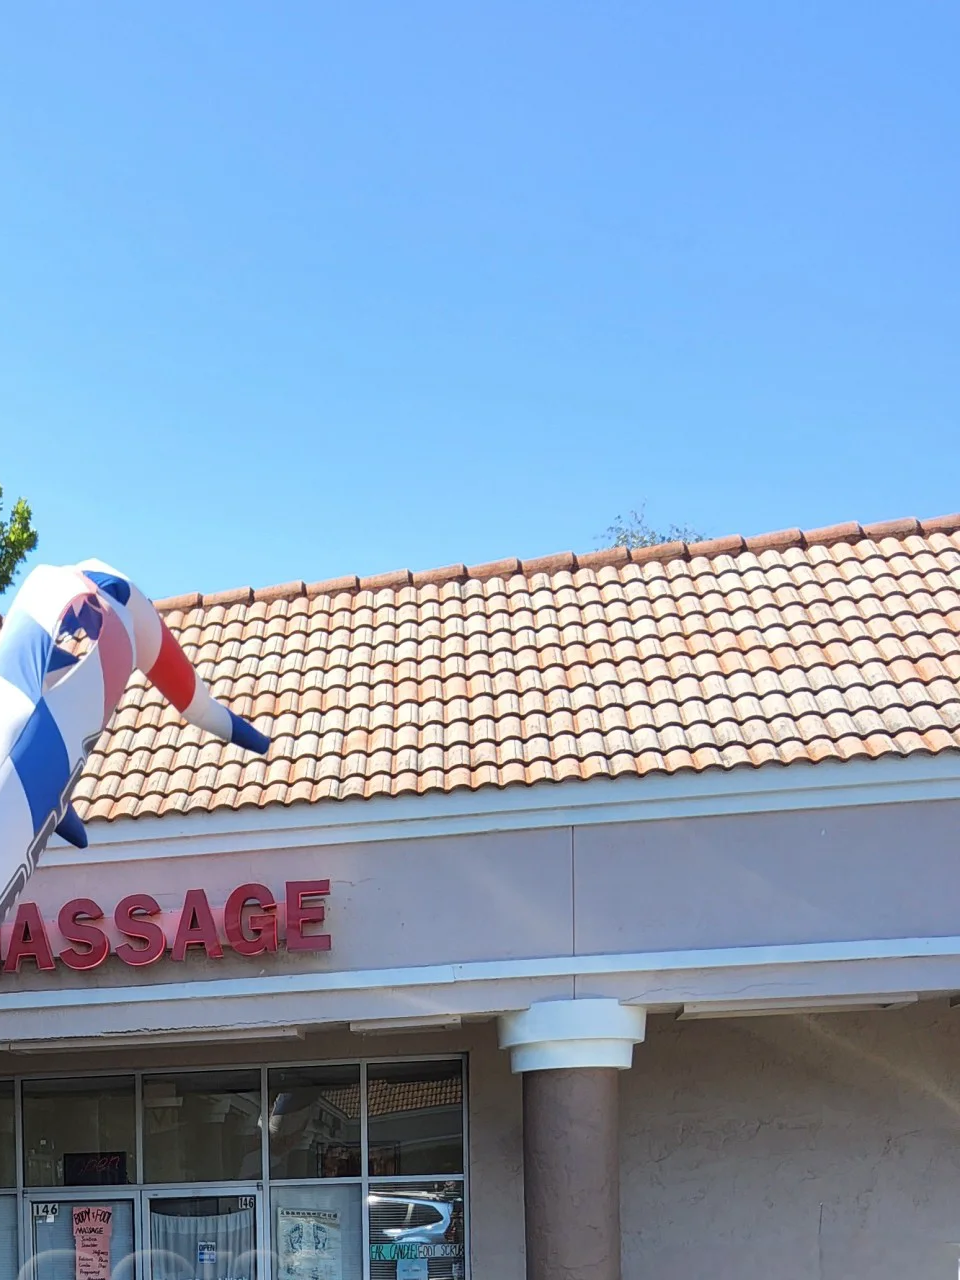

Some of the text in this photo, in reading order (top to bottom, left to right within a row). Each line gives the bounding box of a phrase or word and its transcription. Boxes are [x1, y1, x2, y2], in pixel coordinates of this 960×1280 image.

[240, 1197, 254, 1209] 146
[36, 1204, 58, 1215] 146
[371, 1244, 386, 1260] EAR
